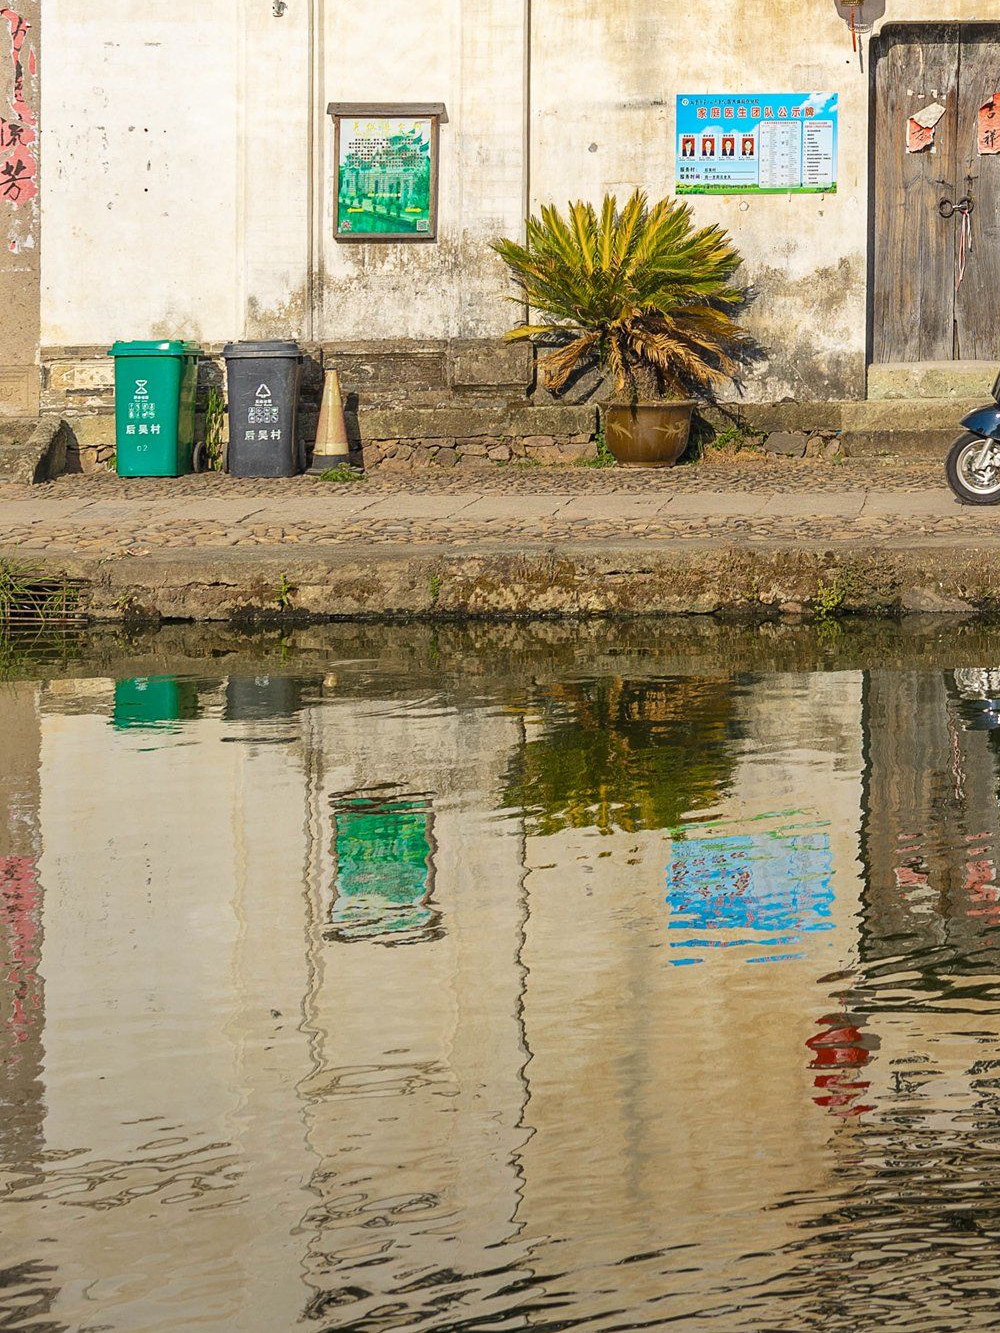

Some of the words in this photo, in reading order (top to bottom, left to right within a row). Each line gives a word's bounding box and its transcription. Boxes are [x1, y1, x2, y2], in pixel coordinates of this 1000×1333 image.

[698, 107, 815, 118] 家庭医生团队公示牌
[126, 424, 160, 434] 后吴村
[245, 429, 281, 440] 后吴村
